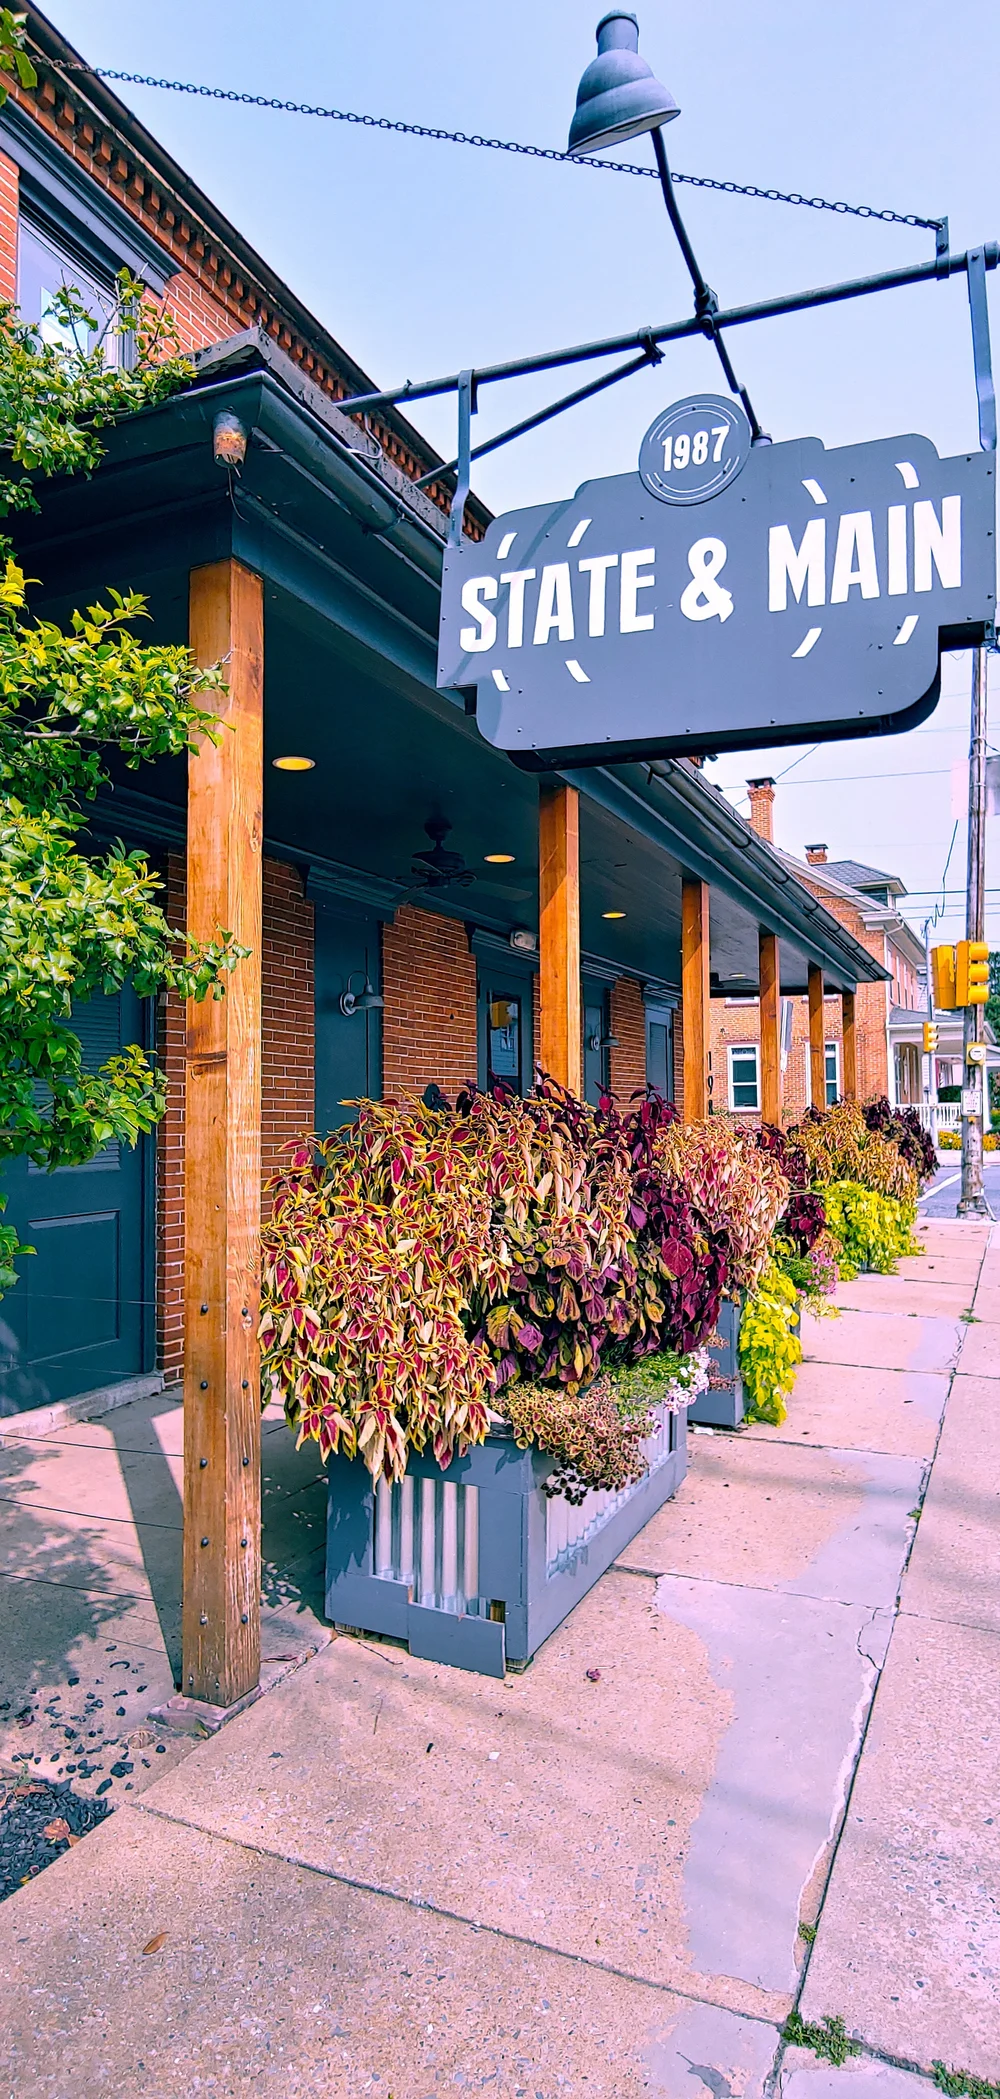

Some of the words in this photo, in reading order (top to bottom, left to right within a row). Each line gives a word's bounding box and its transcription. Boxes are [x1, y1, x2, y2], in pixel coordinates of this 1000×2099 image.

[661, 425, 731, 472] 1987
[459, 547, 656, 653] STATE
[680, 537, 734, 623] &
[768, 495, 962, 612] MAIN
